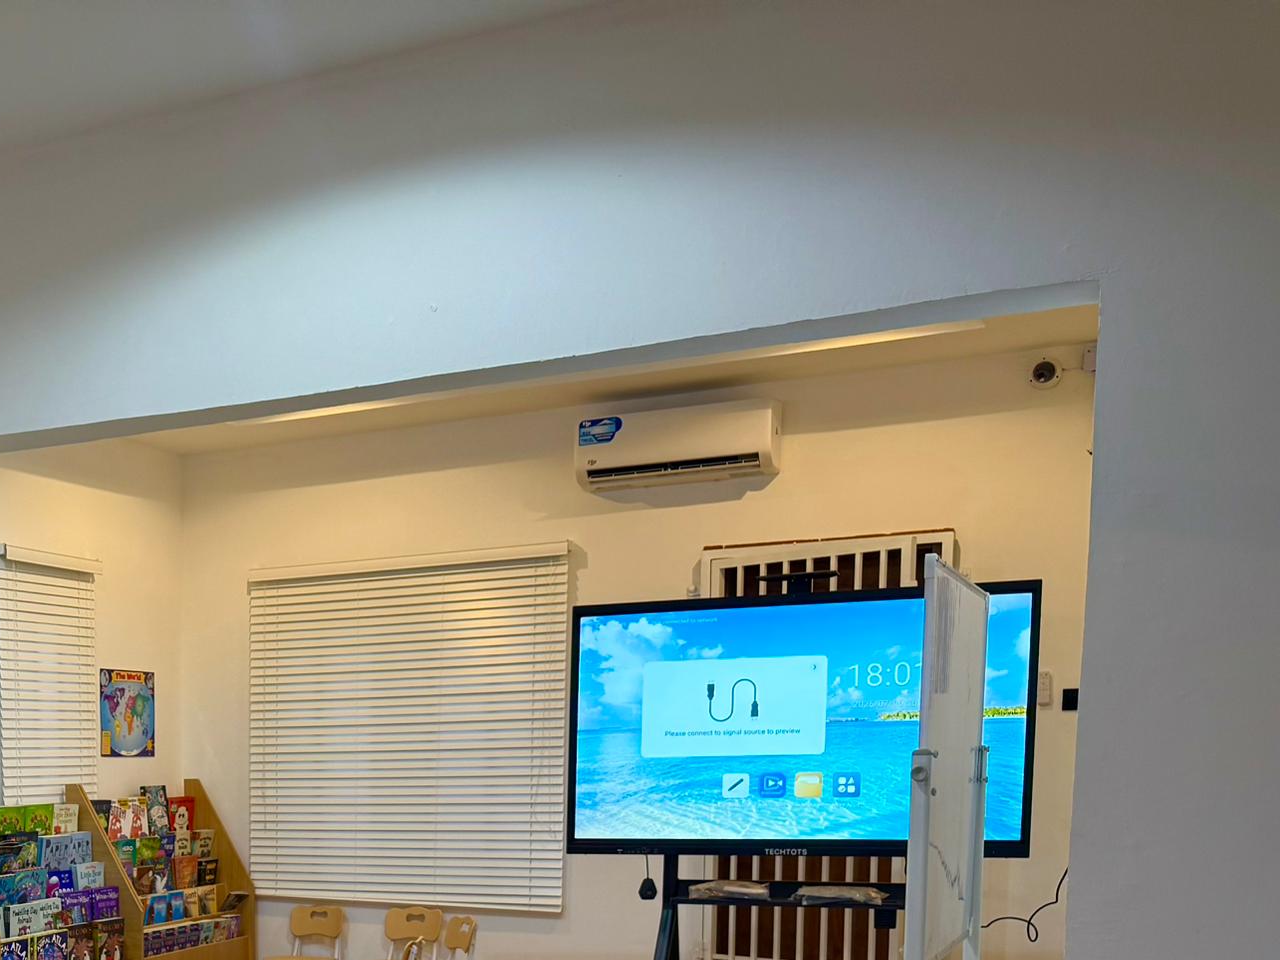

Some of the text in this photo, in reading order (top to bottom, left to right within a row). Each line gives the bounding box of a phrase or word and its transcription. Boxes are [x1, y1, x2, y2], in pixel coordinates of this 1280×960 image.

[127, 673, 142, 681] World
[848, 661, 922, 687] 18:0
[723, 729, 742, 737] signal
[764, 848, 808, 856] TECHTOTS
